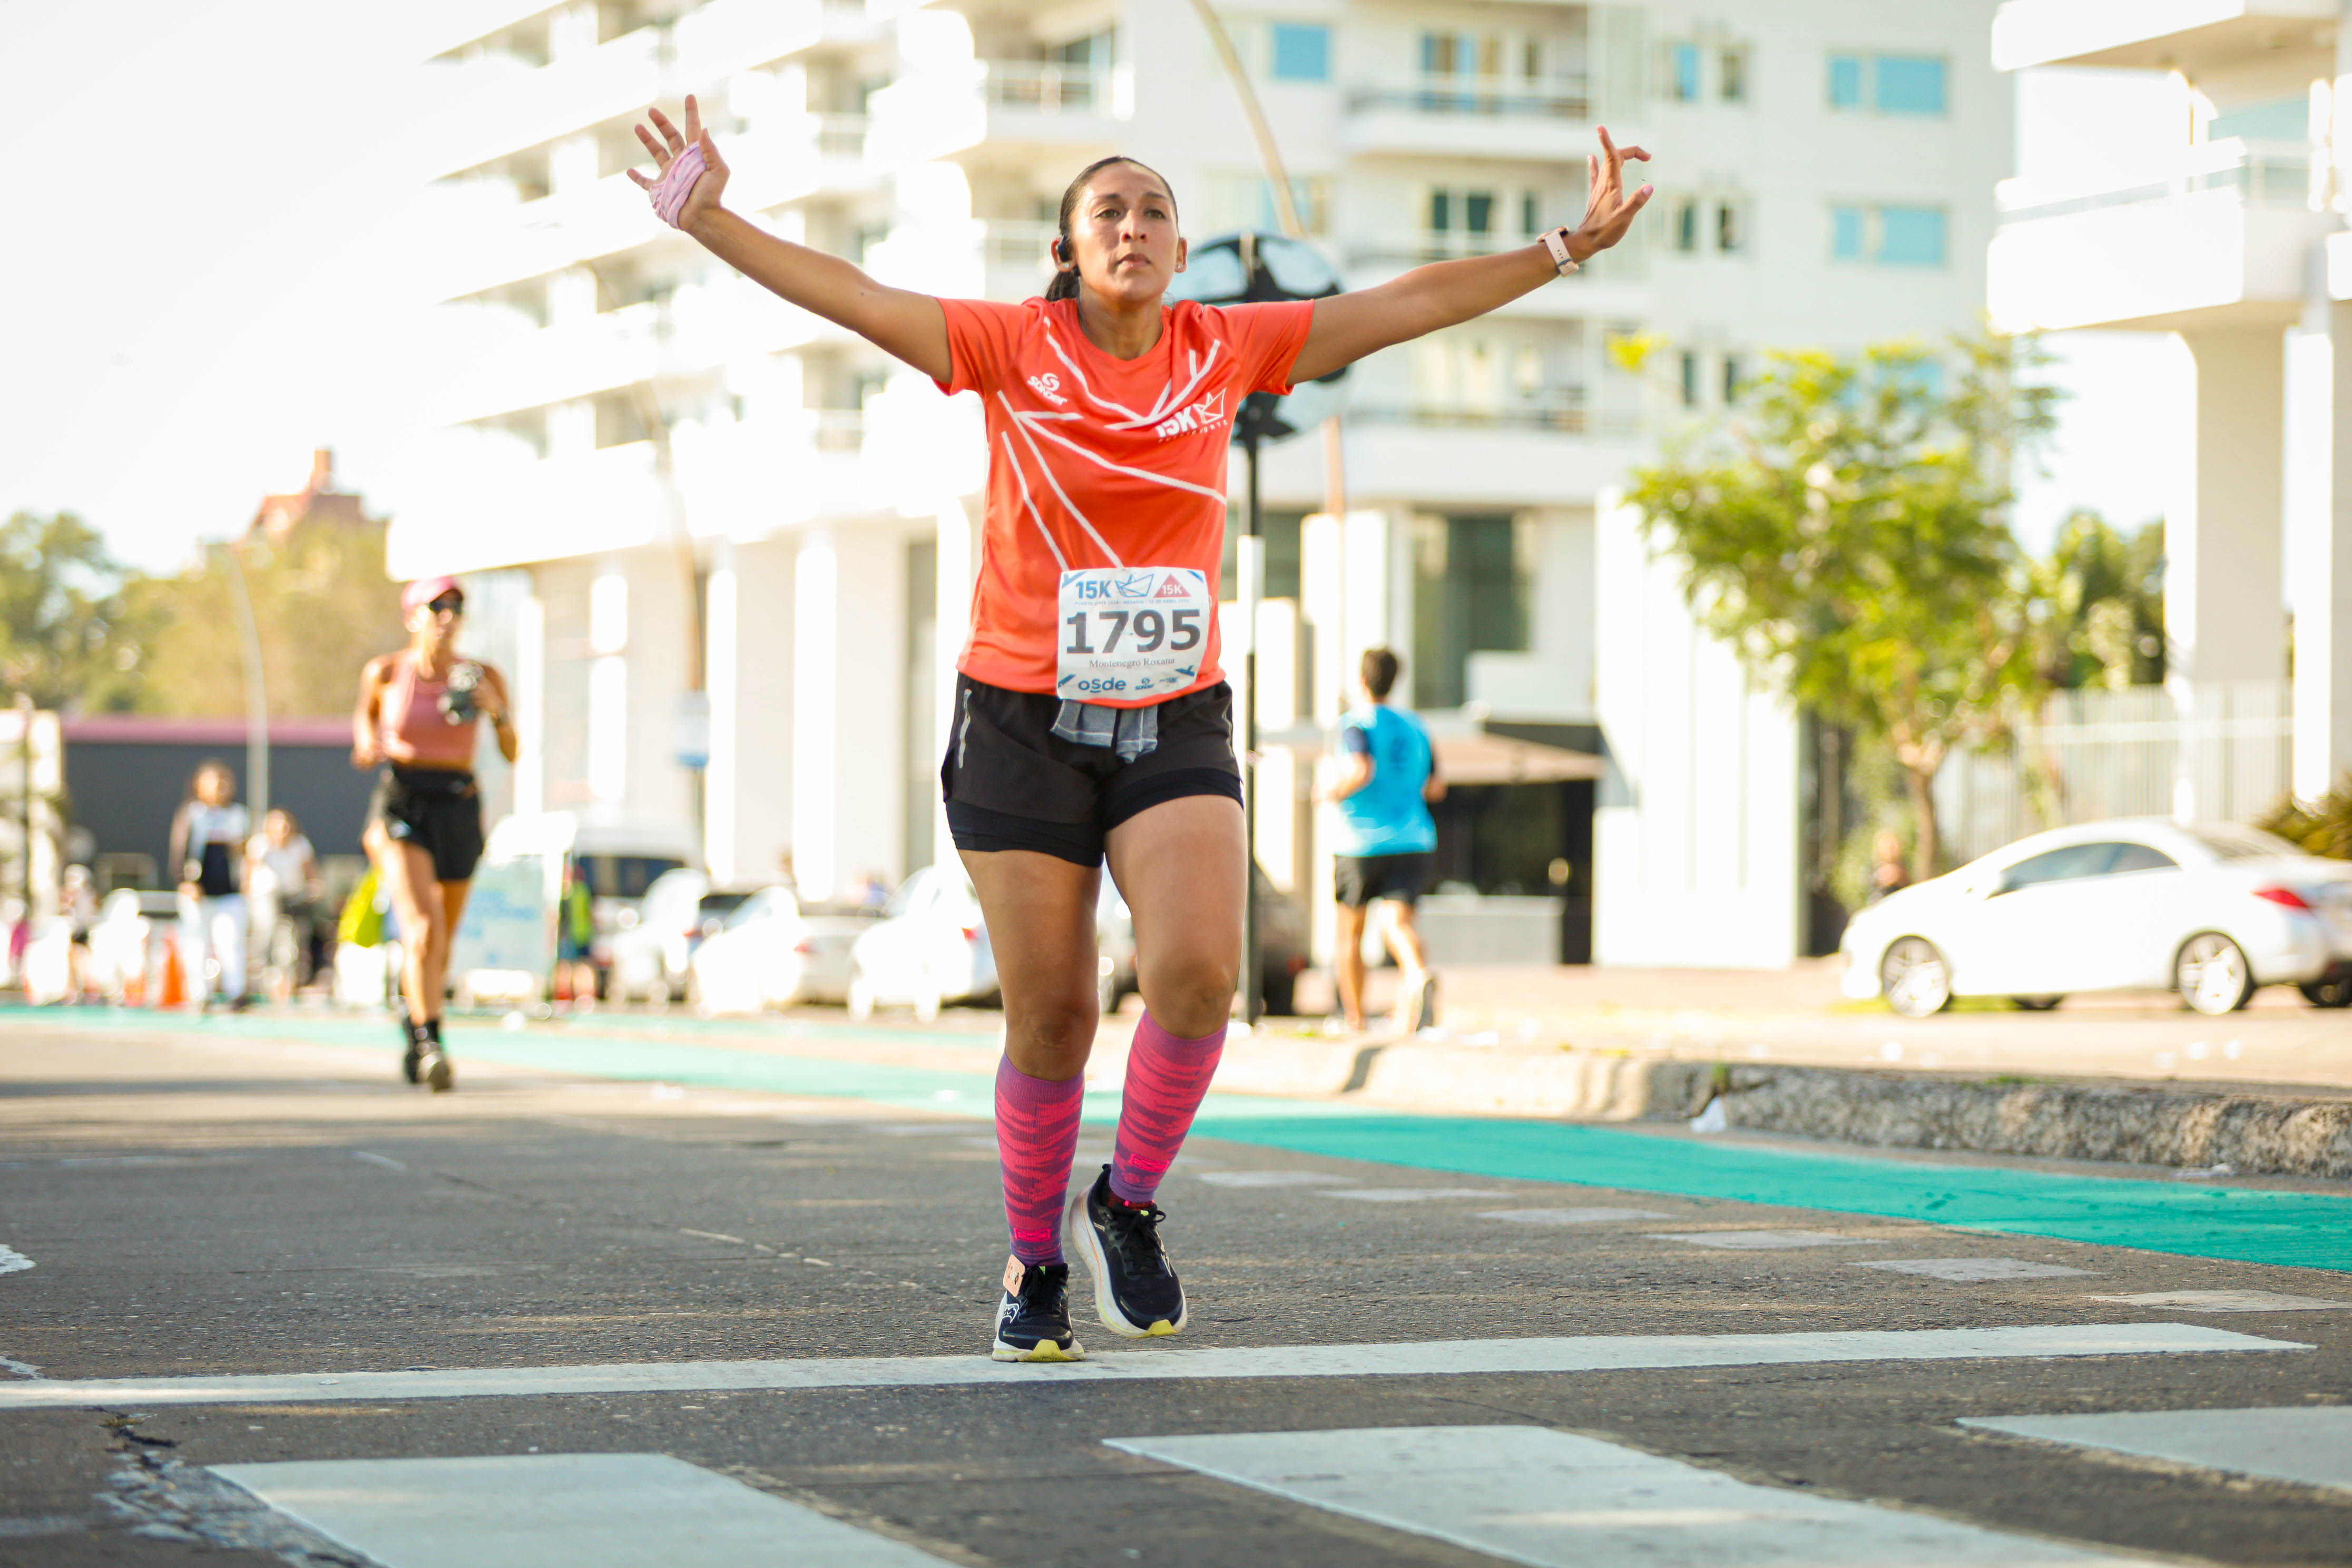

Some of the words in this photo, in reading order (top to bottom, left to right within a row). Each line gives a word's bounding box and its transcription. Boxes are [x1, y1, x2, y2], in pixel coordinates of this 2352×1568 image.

[1076, 580, 1112, 599] 15K
[1161, 584, 1182, 595] 15K
[1066, 609, 1201, 654] 1795
[1089, 659, 1141, 669] Montenegro
[1143, 658, 1175, 667] Roxana
[1078, 677, 1126, 692] osde
